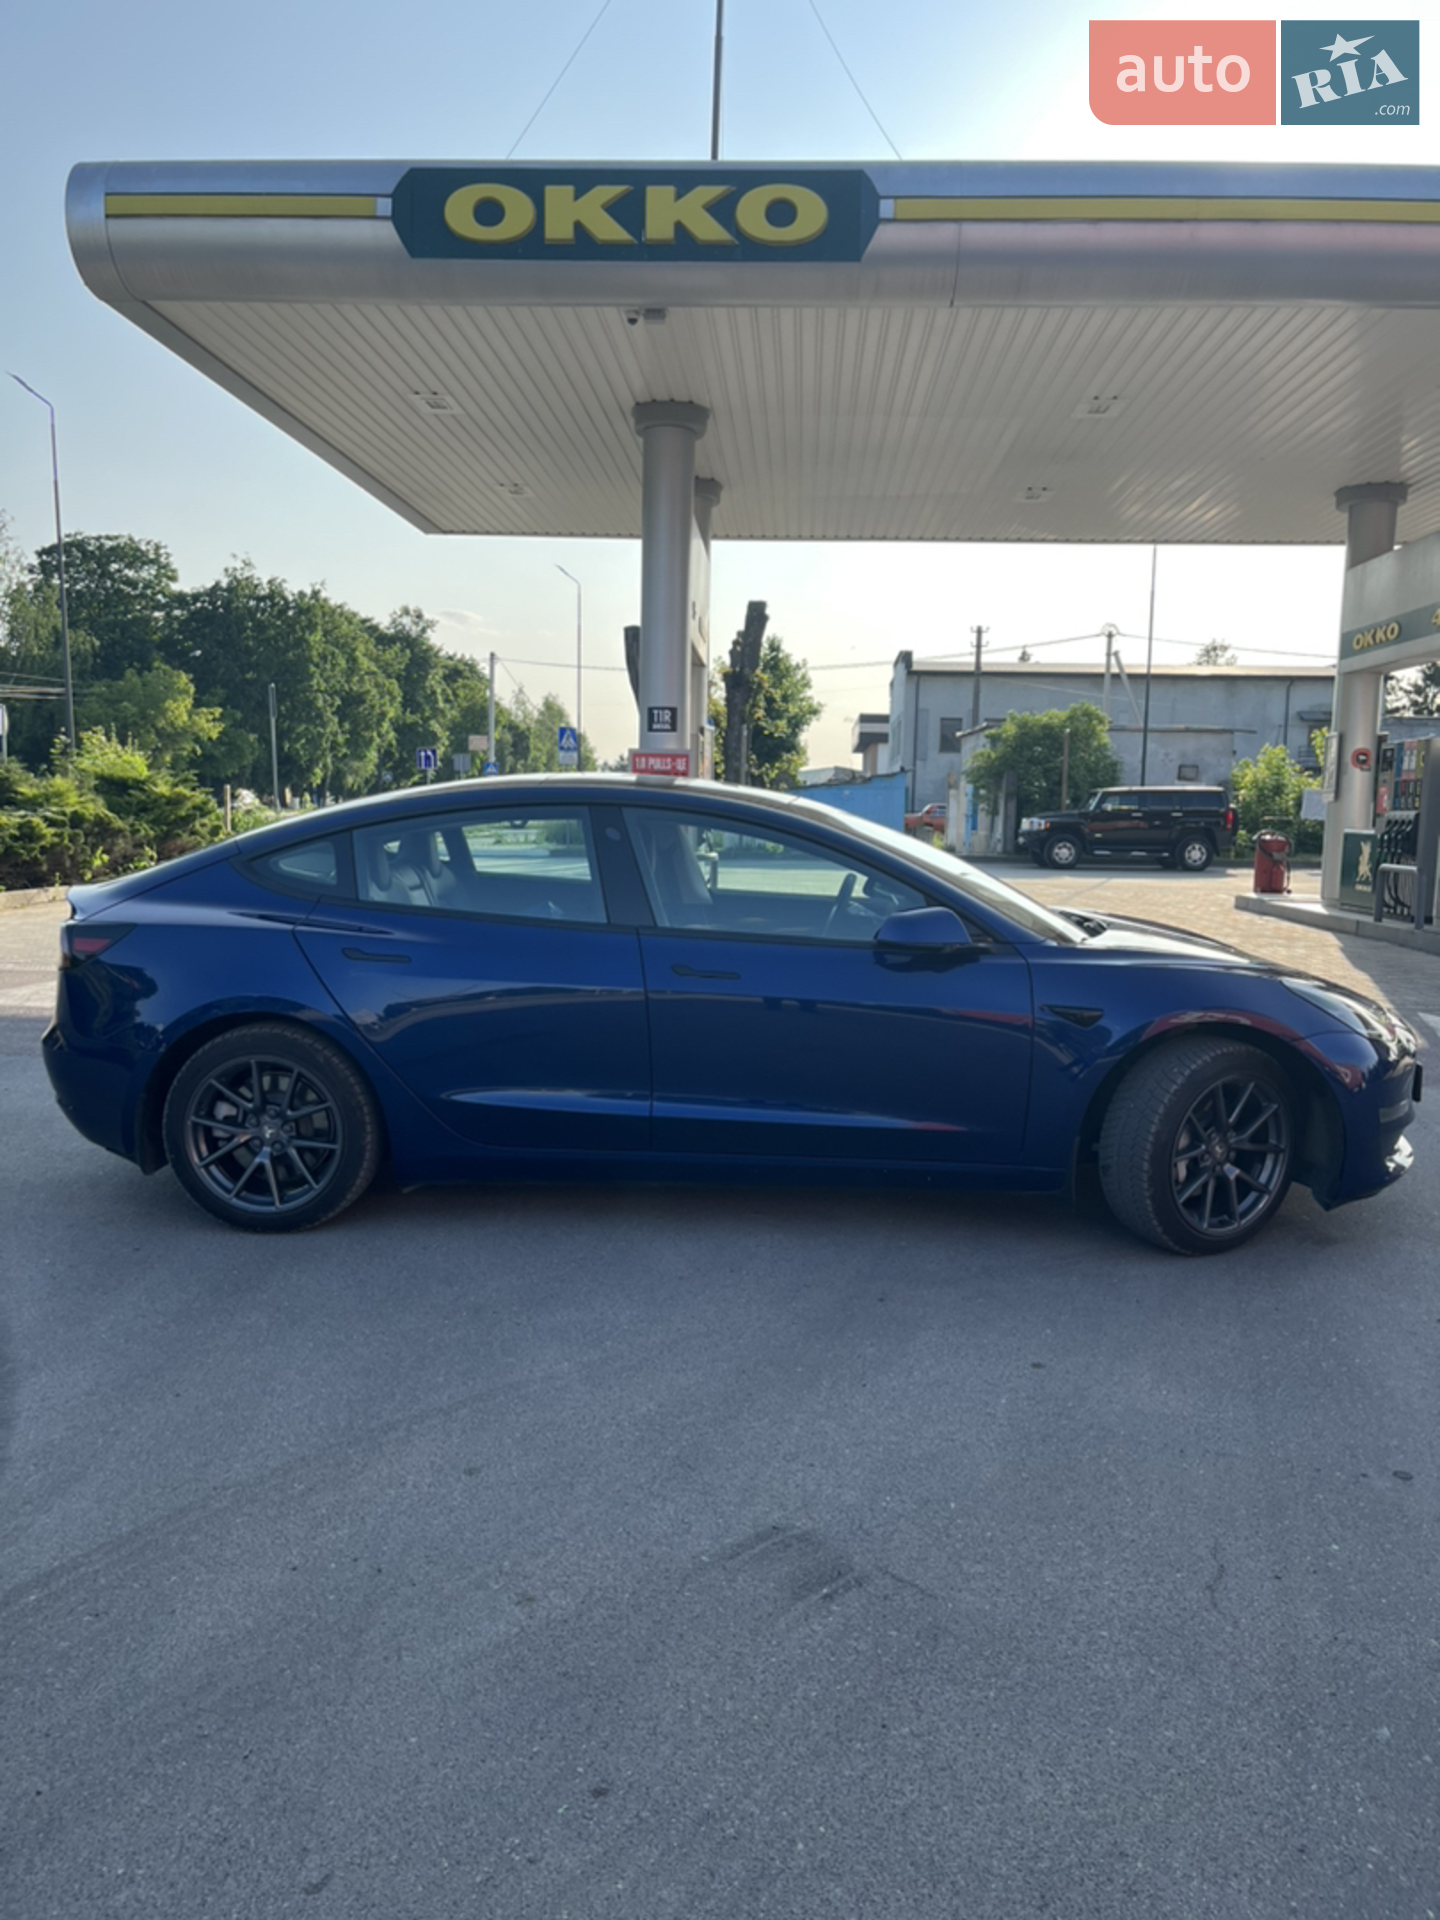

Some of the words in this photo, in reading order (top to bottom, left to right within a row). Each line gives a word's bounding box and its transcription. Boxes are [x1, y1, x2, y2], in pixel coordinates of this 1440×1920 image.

[444, 182, 829, 247] OKKO
[1351, 621, 1400, 651] OKKO
[652, 709, 672, 723] TIR
